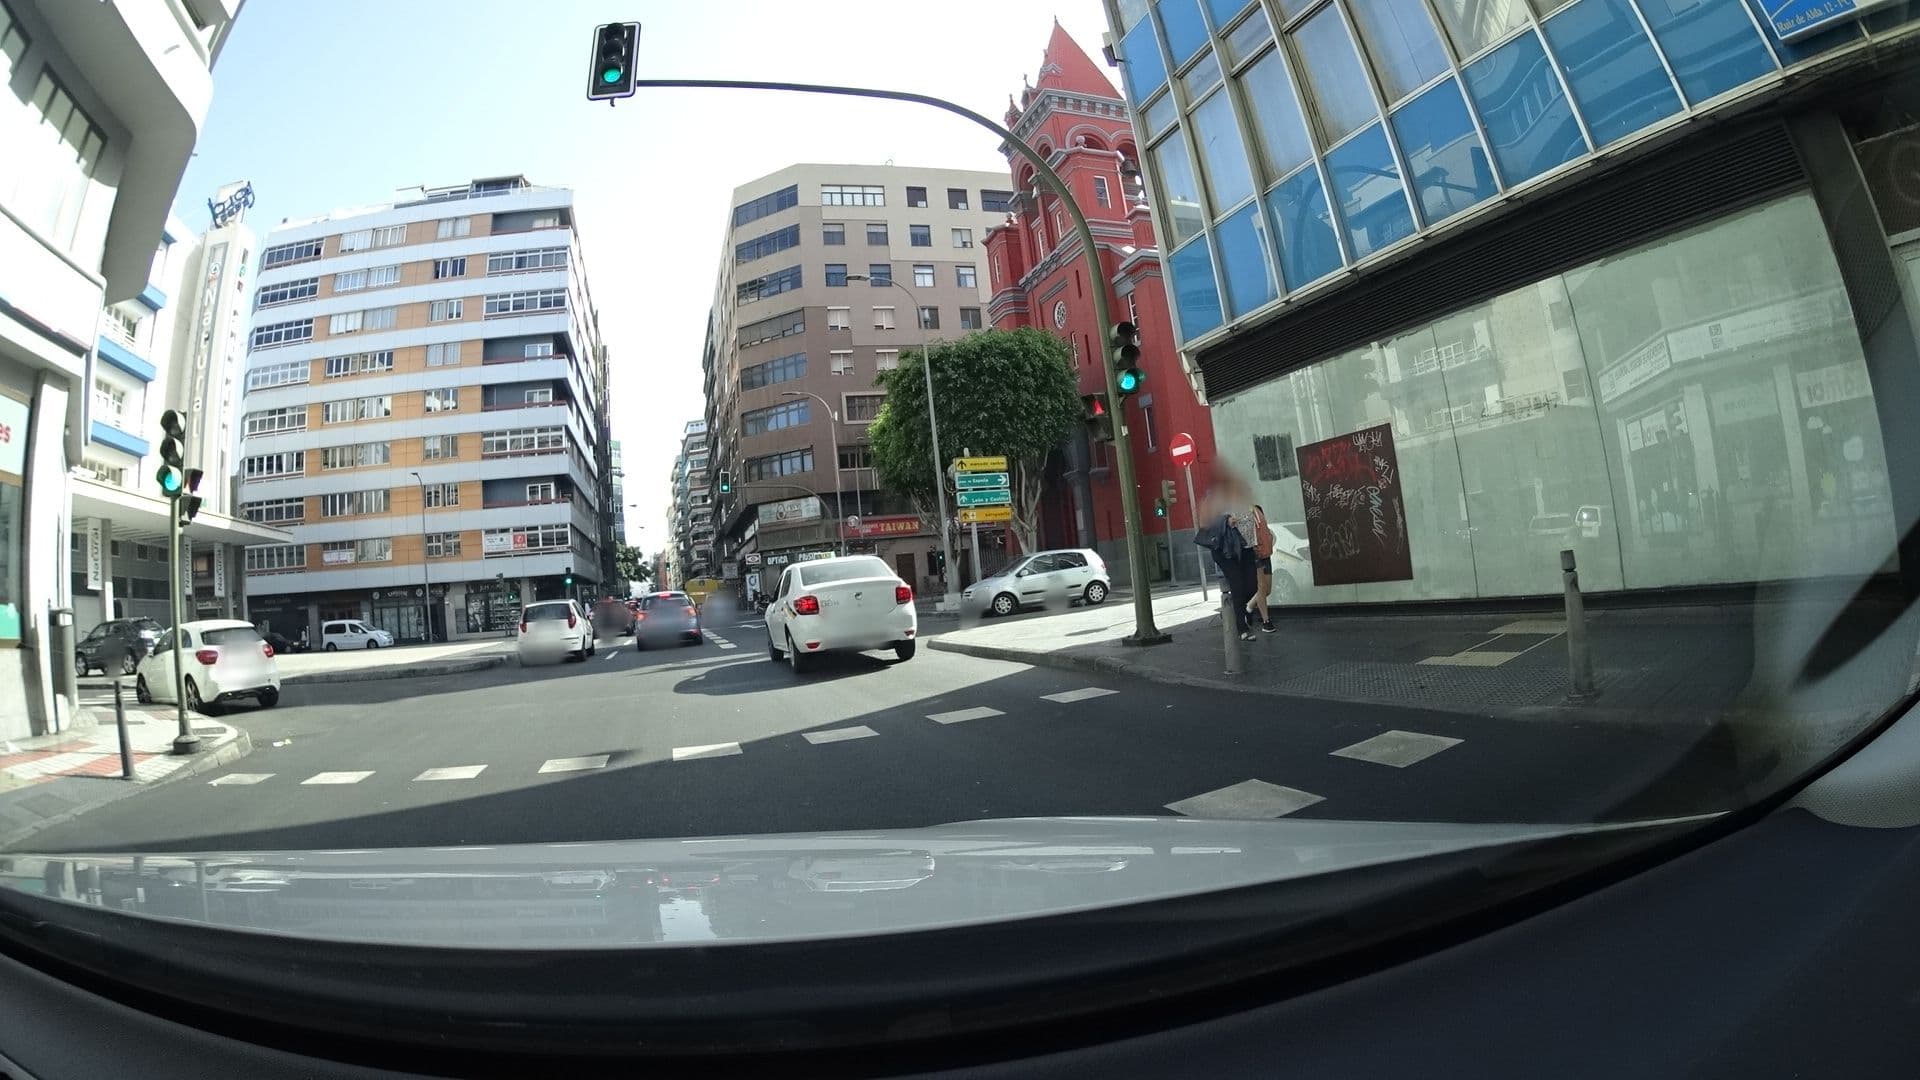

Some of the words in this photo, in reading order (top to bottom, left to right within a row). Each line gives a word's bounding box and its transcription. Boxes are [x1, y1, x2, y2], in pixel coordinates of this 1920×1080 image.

[1795, 14, 1806, 25] de
[880, 521, 919, 532] TAIWAN
[92, 527, 100, 582] Natural
